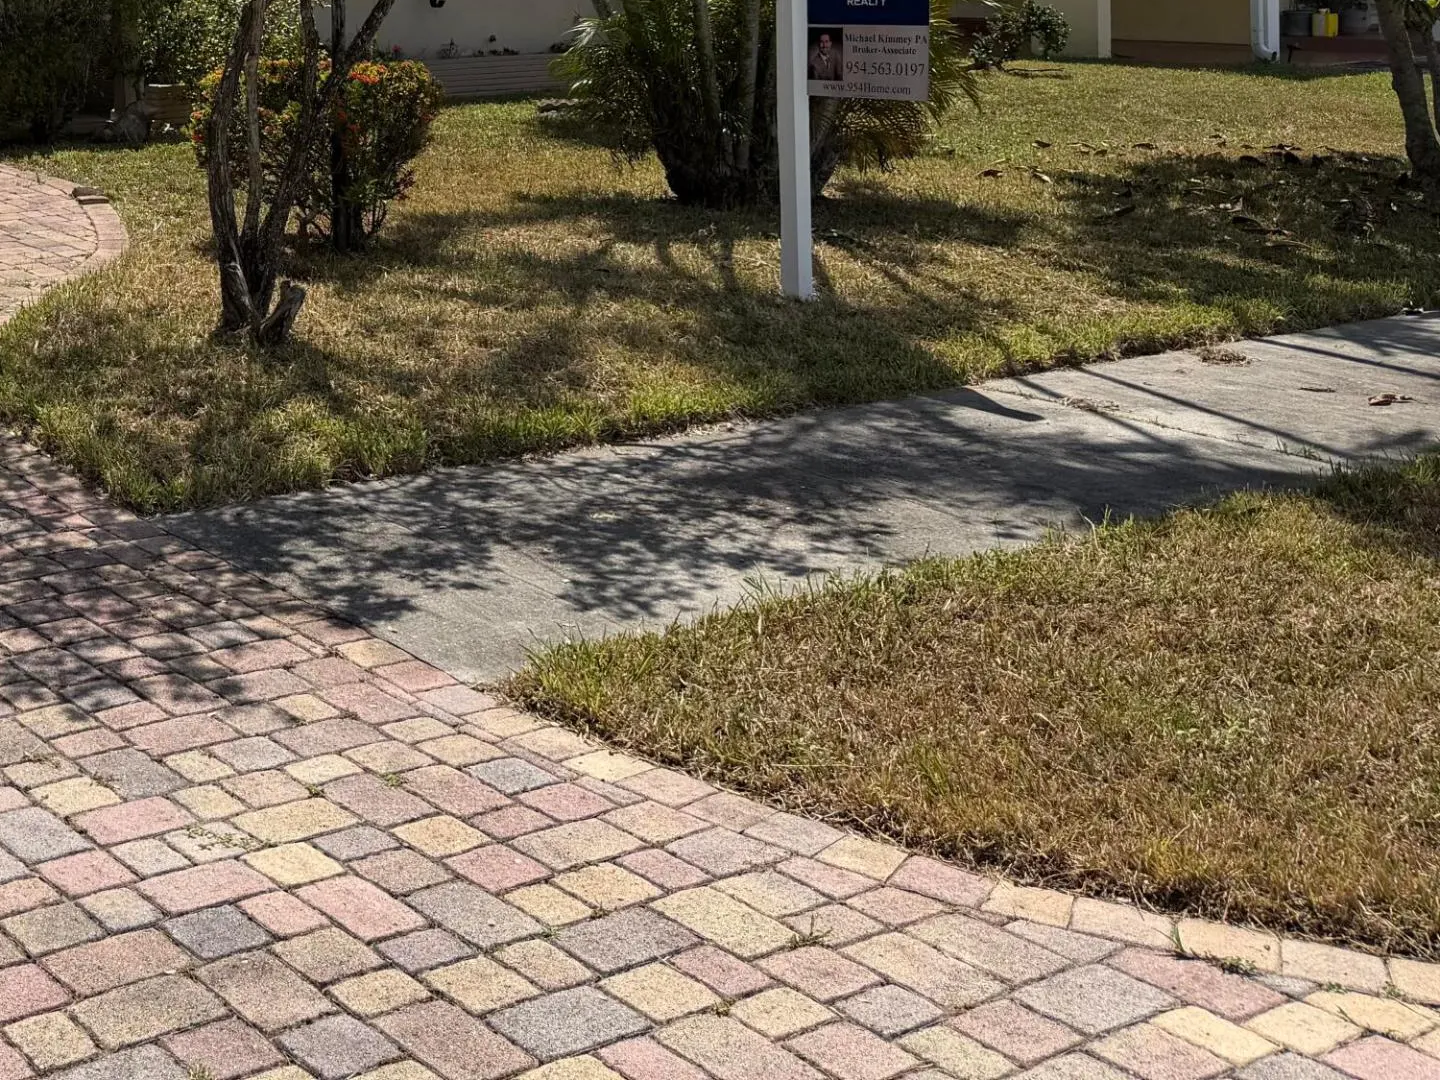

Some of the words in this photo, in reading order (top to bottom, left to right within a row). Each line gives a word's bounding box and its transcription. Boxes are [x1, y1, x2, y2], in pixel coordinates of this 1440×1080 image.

[845, 33, 876, 43] Michael
[846, 61, 925, 77] 954.563.0197
[823, 83, 912, 96] www.954Home.com
